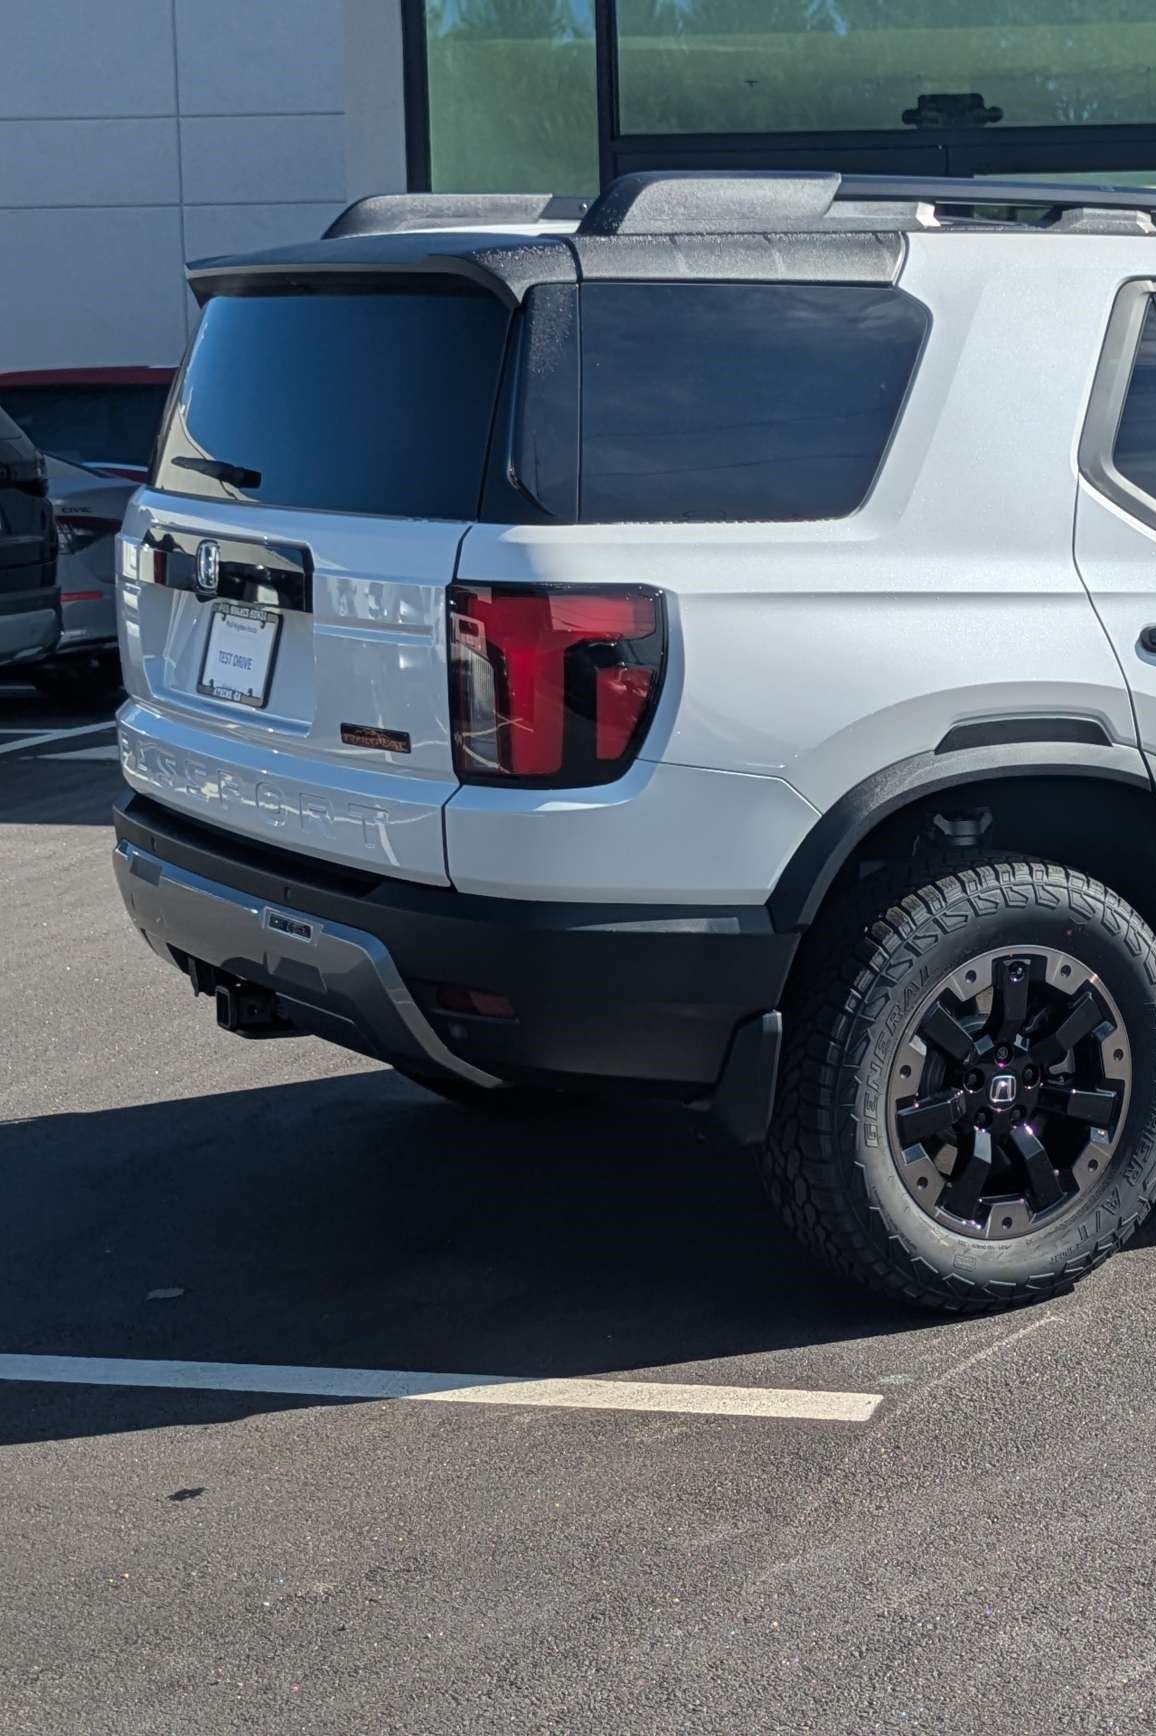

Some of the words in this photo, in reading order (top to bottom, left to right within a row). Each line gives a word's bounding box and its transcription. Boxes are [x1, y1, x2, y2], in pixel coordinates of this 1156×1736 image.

[218, 650, 234, 665] TEST
[232, 653, 253, 671] DRIVE
[120, 731, 390, 849] PASSPORT
[864, 966, 931, 1149] GENERAL
